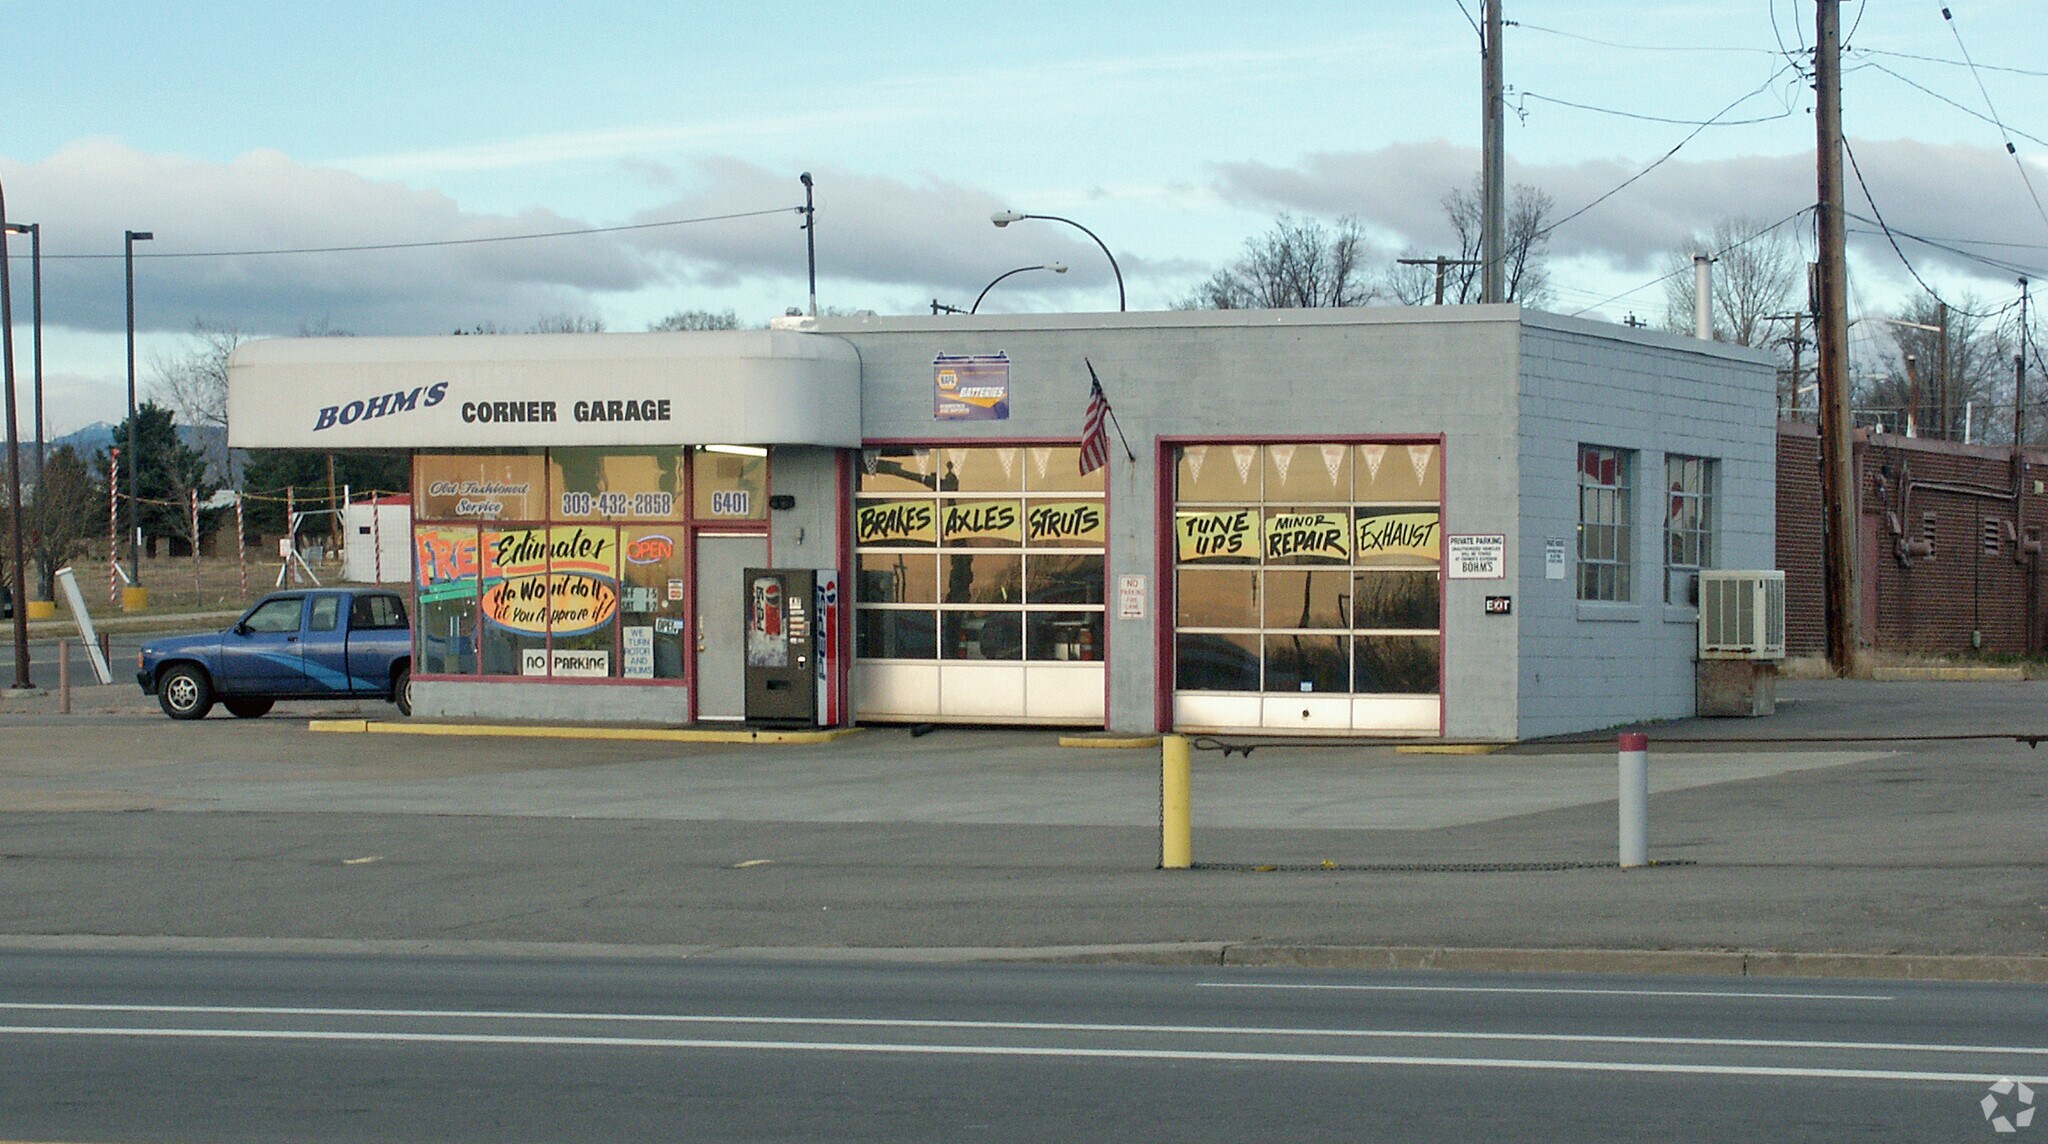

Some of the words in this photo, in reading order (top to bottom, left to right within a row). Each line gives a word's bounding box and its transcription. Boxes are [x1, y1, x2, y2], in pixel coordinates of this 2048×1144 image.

[960, 386, 1005, 398] BATTERIES
[312, 381, 449, 432] BOHM'S
[461, 401, 557, 423] CORNER
[573, 400, 671, 422] GARAGE
[430, 481, 459, 495] Old
[460, 481, 528, 494] Fashioned
[457, 499, 501, 513] Service
[713, 491, 748, 514] 6401
[860, 505, 931, 539] BRAKES
[944, 505, 1015, 536] AXLES
[1029, 506, 1100, 538] STRUTS
[1186, 512, 1250, 537] TUNE
[1275, 514, 1335, 531] MINOR
[1196, 534, 1243, 555] UPS
[1268, 529, 1348, 557] REPAIR
[1450, 537, 1474, 545] PRIVATE
[1476, 537, 1503, 545] PARKING
[627, 541, 673, 559] OPEN
[416, 530, 503, 588] FREE
[1126, 579, 1138, 588] NO
[621, 601, 634, 612] SAT
[1486, 600, 1510, 611] EXIT
[512, 608, 534, 621] You
[631, 629, 645, 637] WE
[526, 656, 545, 668] NO
[554, 657, 605, 670] PARKING
